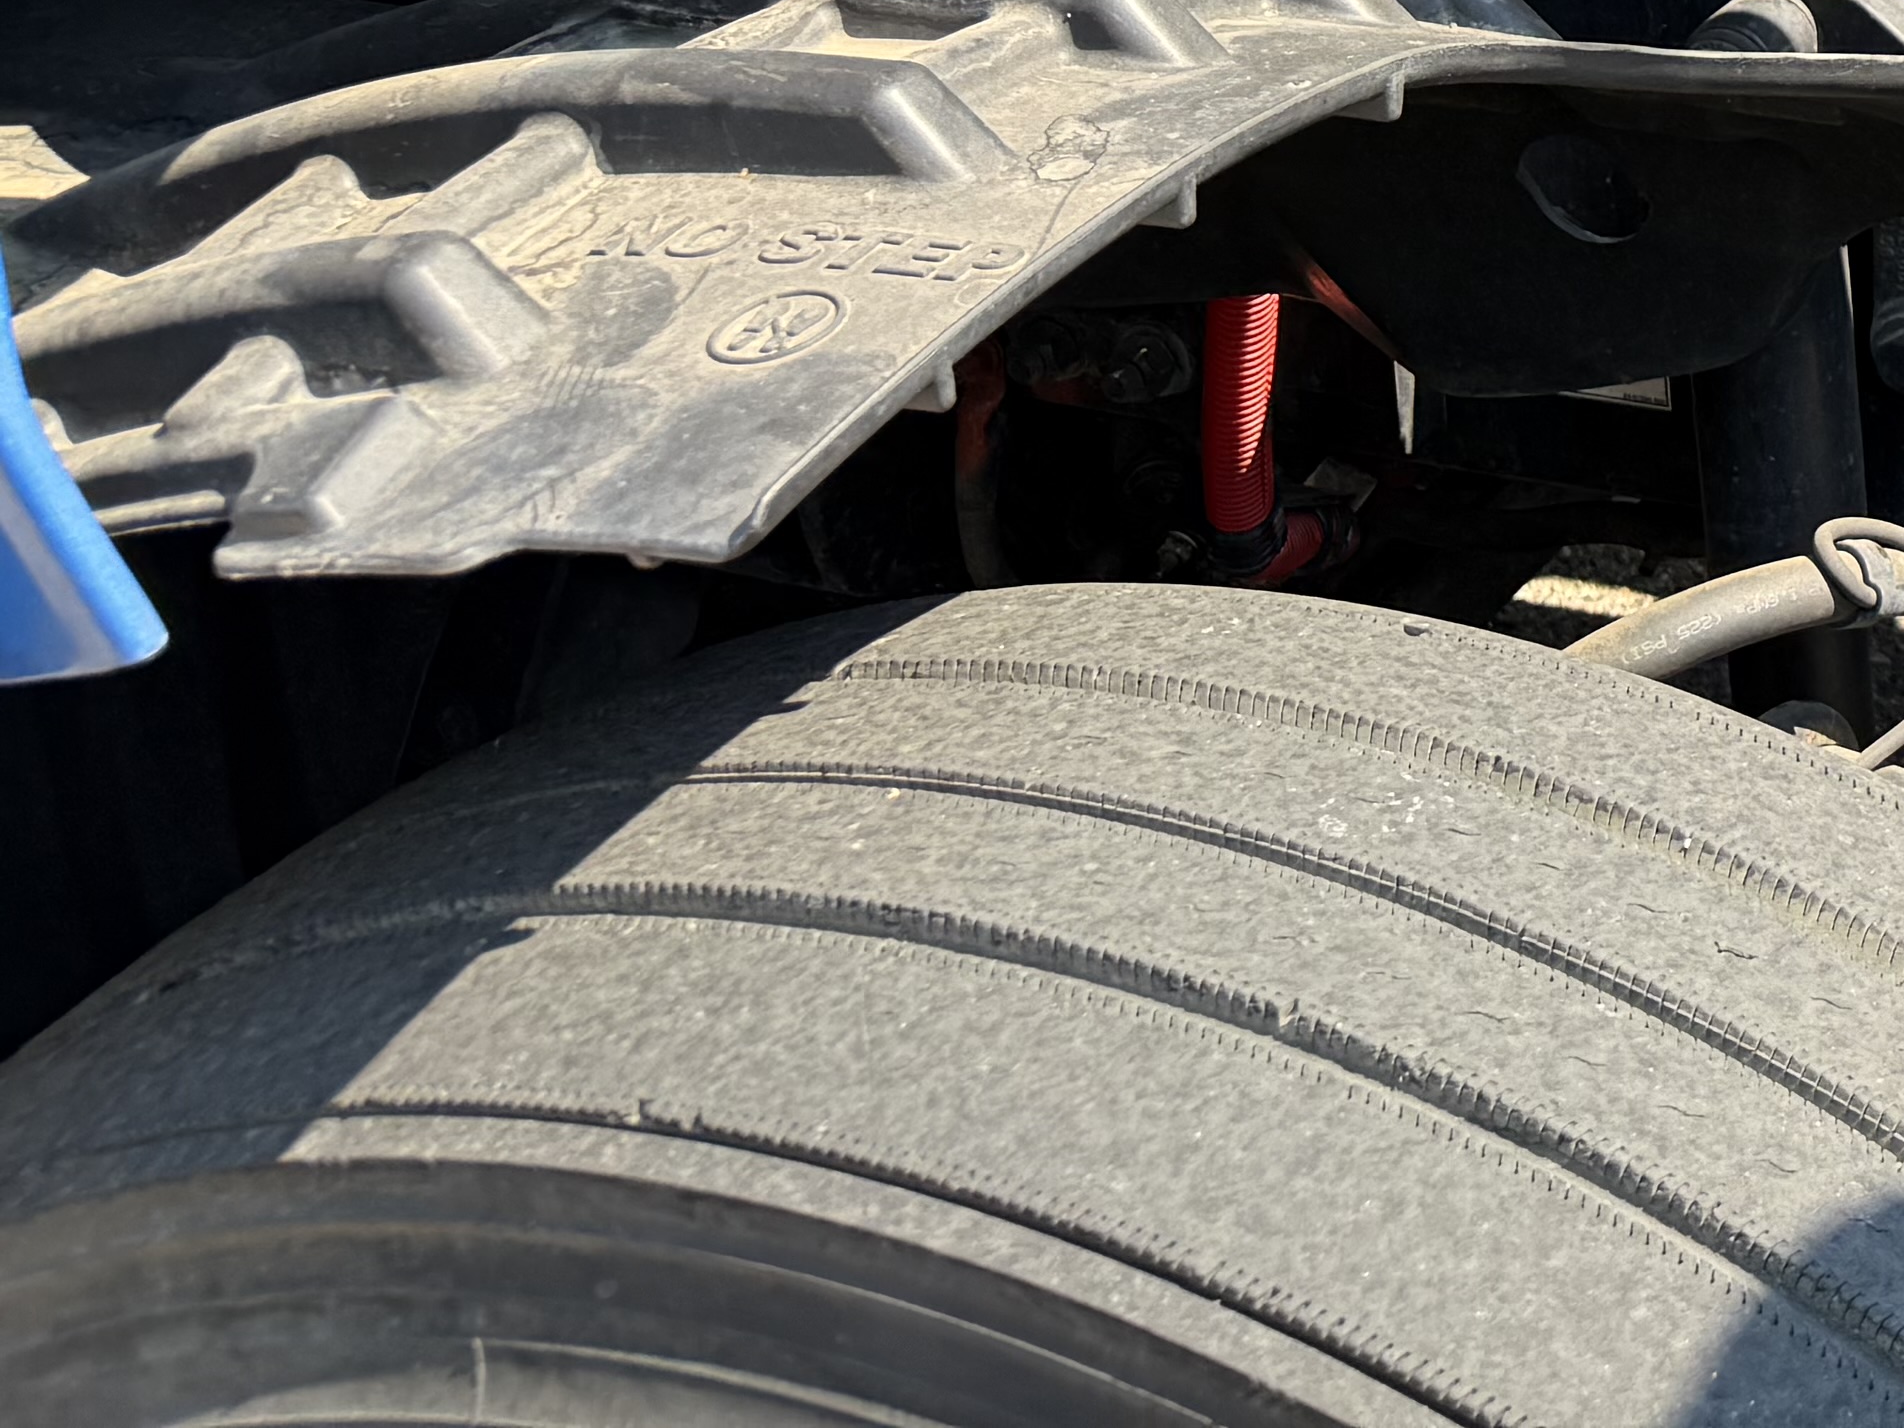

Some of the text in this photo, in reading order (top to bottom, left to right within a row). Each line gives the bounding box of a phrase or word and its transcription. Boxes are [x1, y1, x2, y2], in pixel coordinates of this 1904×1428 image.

[585, 214, 1029, 284] NO STEP
[1676, 612, 1723, 641] (225
[1621, 633, 1669, 665] PSI)
